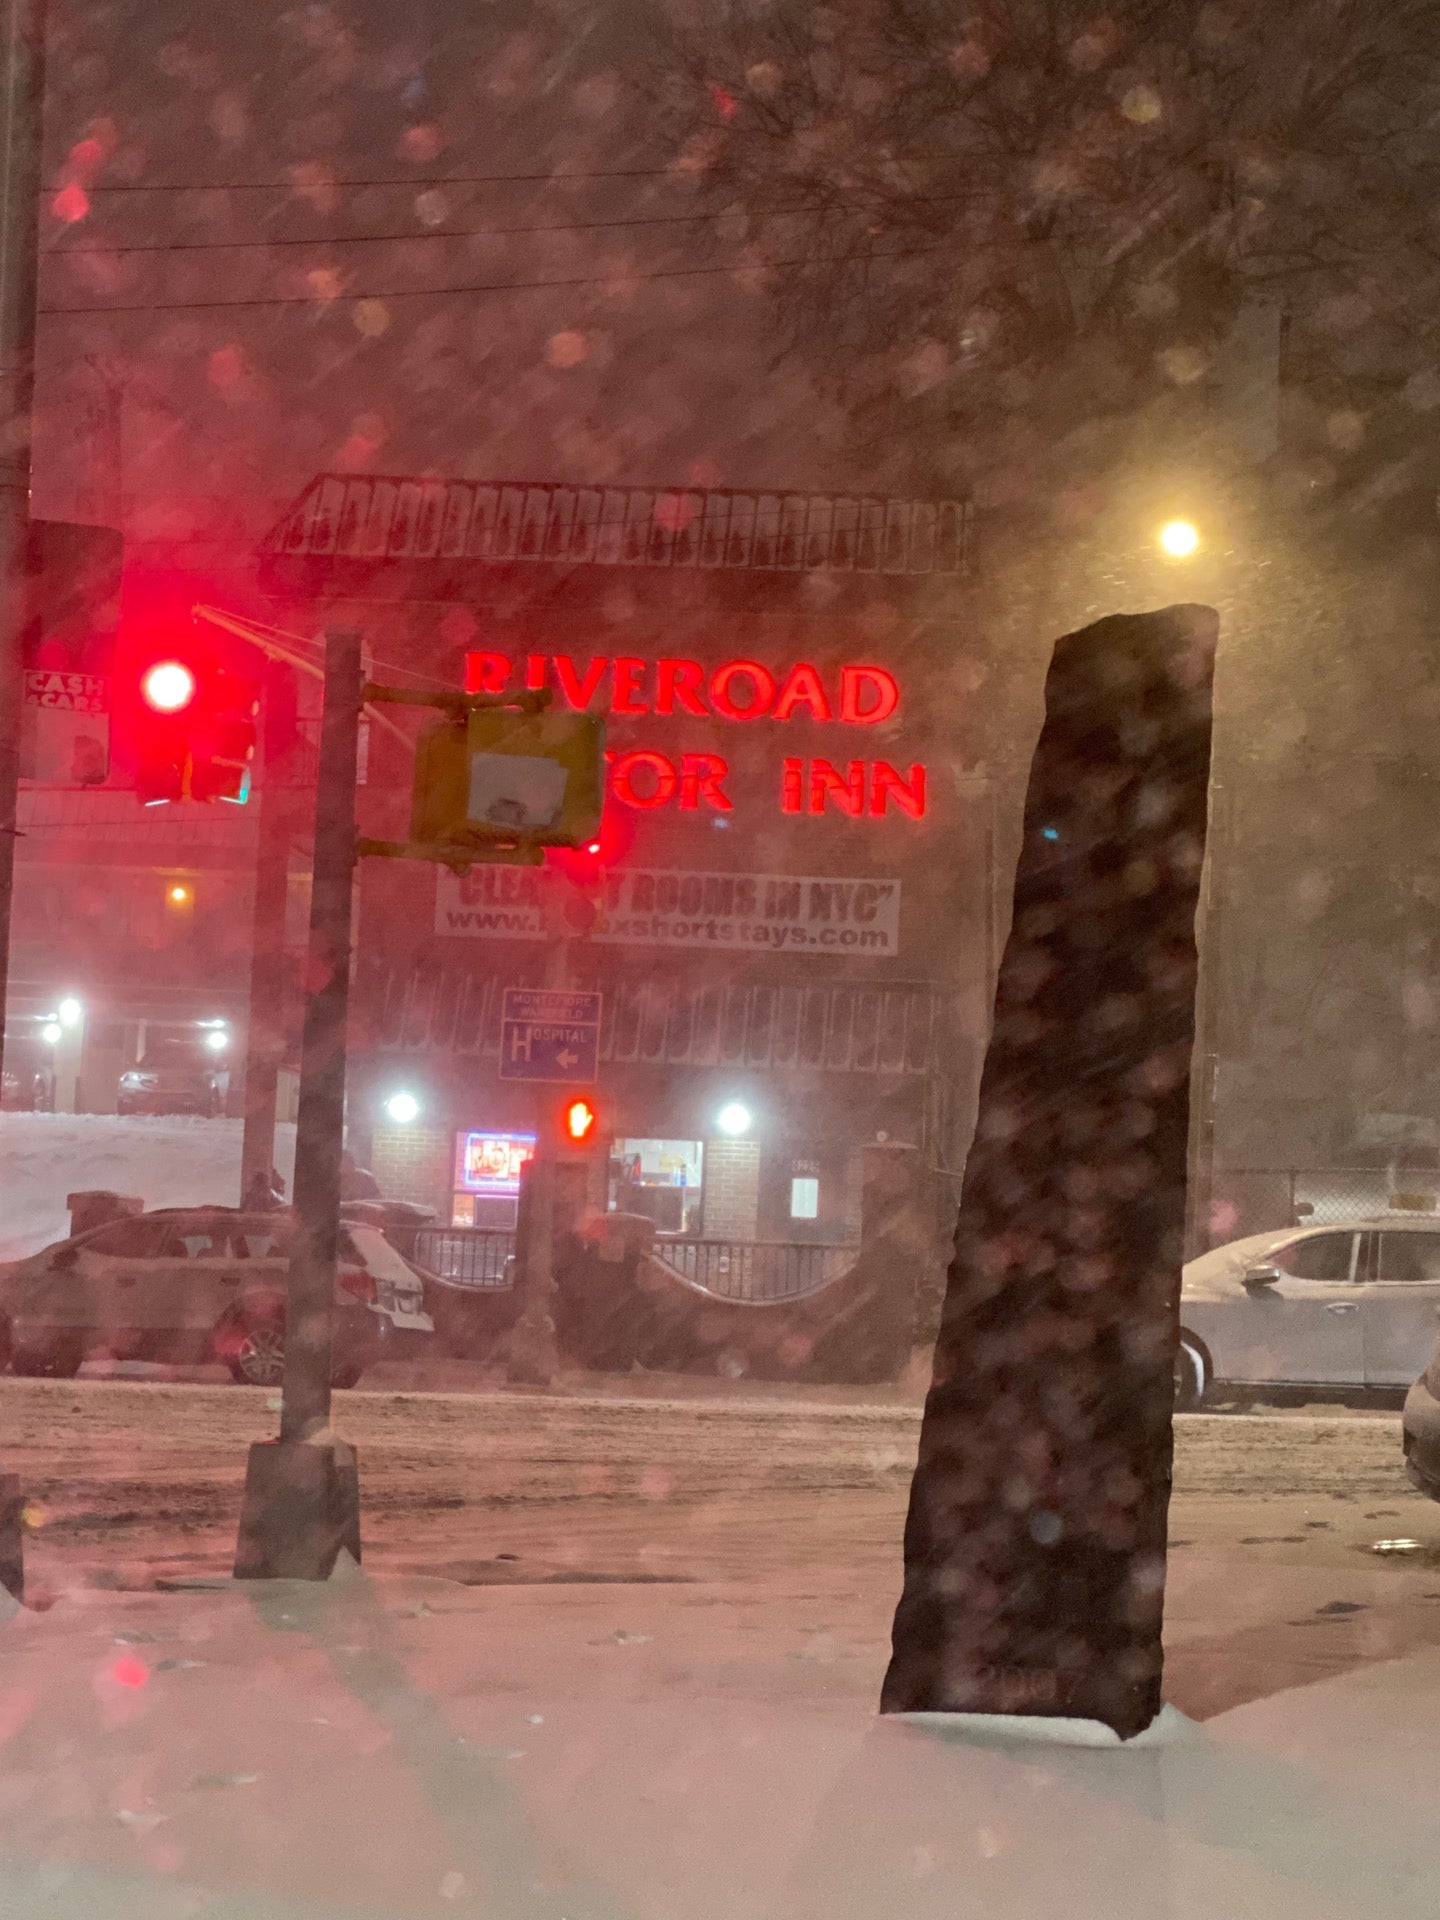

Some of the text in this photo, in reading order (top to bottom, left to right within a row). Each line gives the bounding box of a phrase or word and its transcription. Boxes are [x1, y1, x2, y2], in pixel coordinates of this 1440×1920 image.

[28, 674, 105, 696] CASH
[464, 651, 900, 724] RIVEROAD
[604, 750, 927, 819] OR INN
[631, 874, 757, 918] ROOMS
[764, 881, 801, 920] IN
[511, 1026, 588, 1062] HOSPITAL
